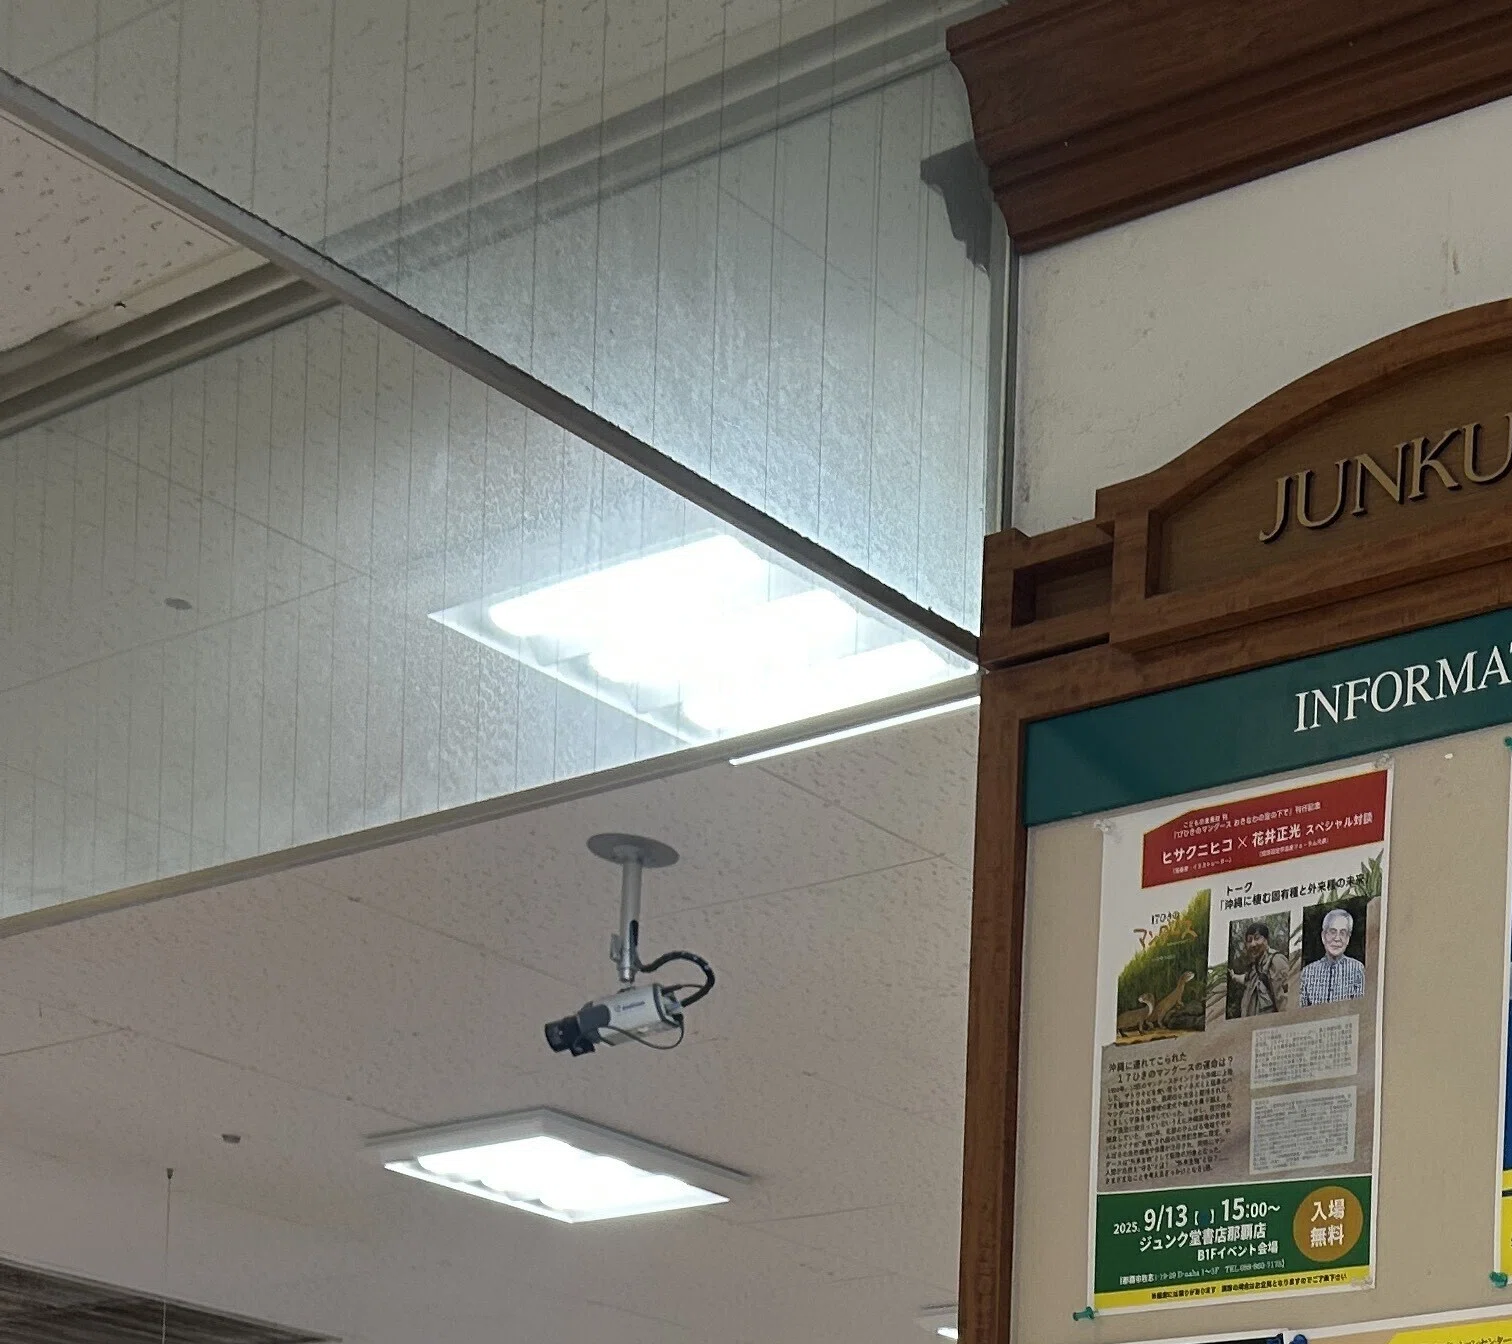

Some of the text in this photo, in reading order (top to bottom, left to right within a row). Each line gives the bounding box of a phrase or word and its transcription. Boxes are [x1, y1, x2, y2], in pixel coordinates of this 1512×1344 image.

[1162, 838, 1233, 865] ヒサクニヒコ
[1252, 824, 1301, 848] 花井正光
[1306, 811, 1373, 836] スペシャル対談
[1226, 882, 1253, 896] トーク
[1113, 1205, 1188, 1234] 2025. 9/13
[1311, 1199, 1345, 1222] 入場
[1139, 1223, 1266, 1252] ジュンク堂書店那覇店
[1310, 1224, 1345, 1247] 無料
[1197, 1241, 1279, 1261] B1Fイベント会場
